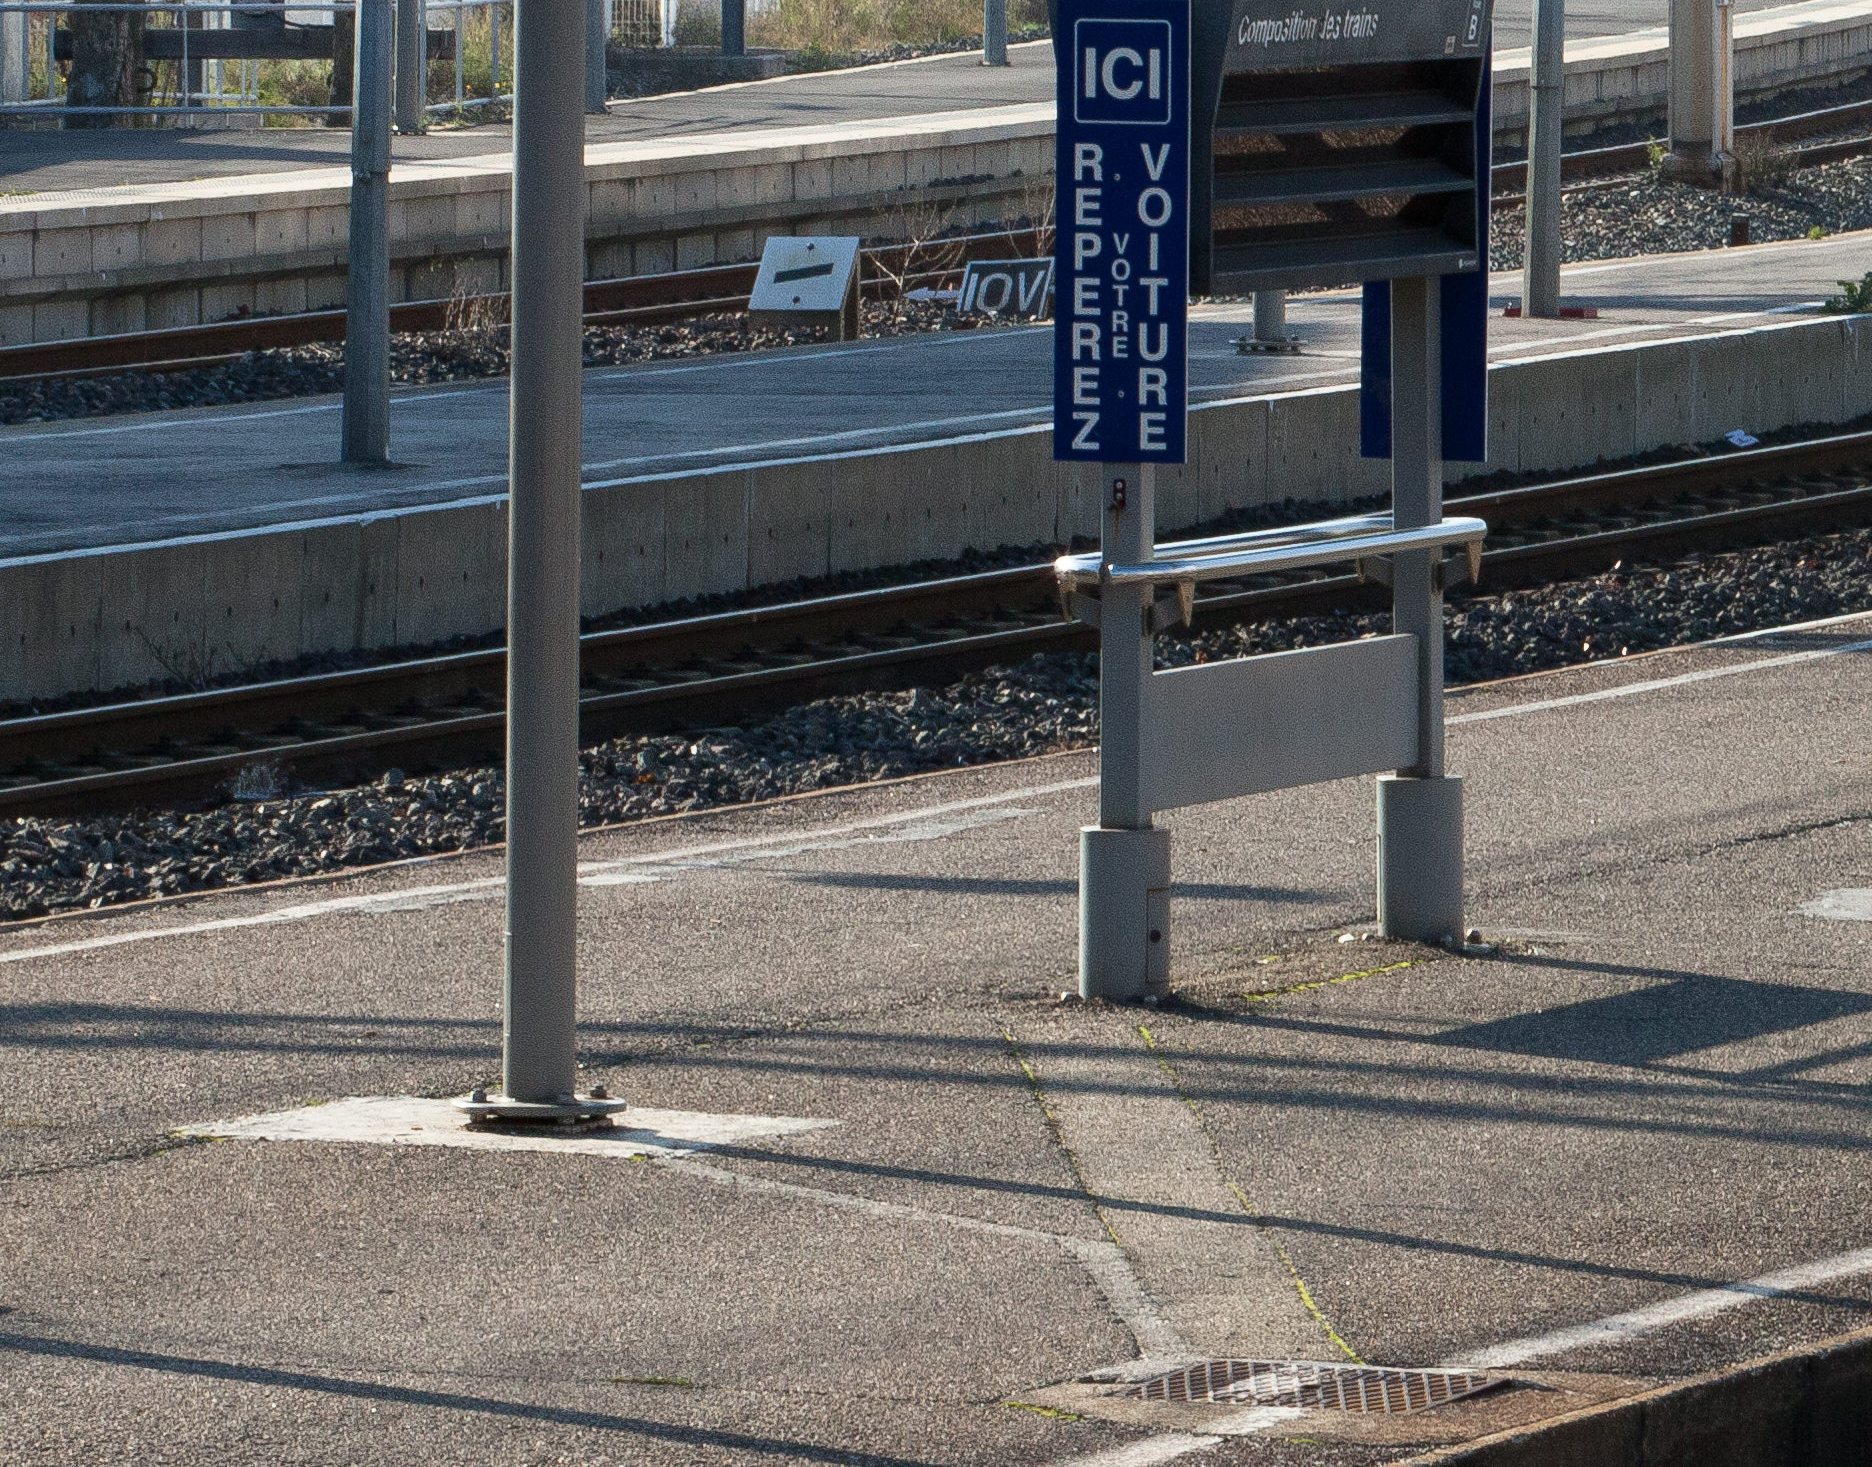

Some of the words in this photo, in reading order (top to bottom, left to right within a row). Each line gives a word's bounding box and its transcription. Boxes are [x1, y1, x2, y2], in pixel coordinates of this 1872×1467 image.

[1084, 47, 1161, 101] ICI
[1237, 8, 1318, 49] Composition
[1343, 6, 1379, 39] trains
[1071, 143, 1104, 451] REPEREZ
[1111, 232, 1129, 359] VOTRE
[1137, 142, 1173, 451] VOITURE
